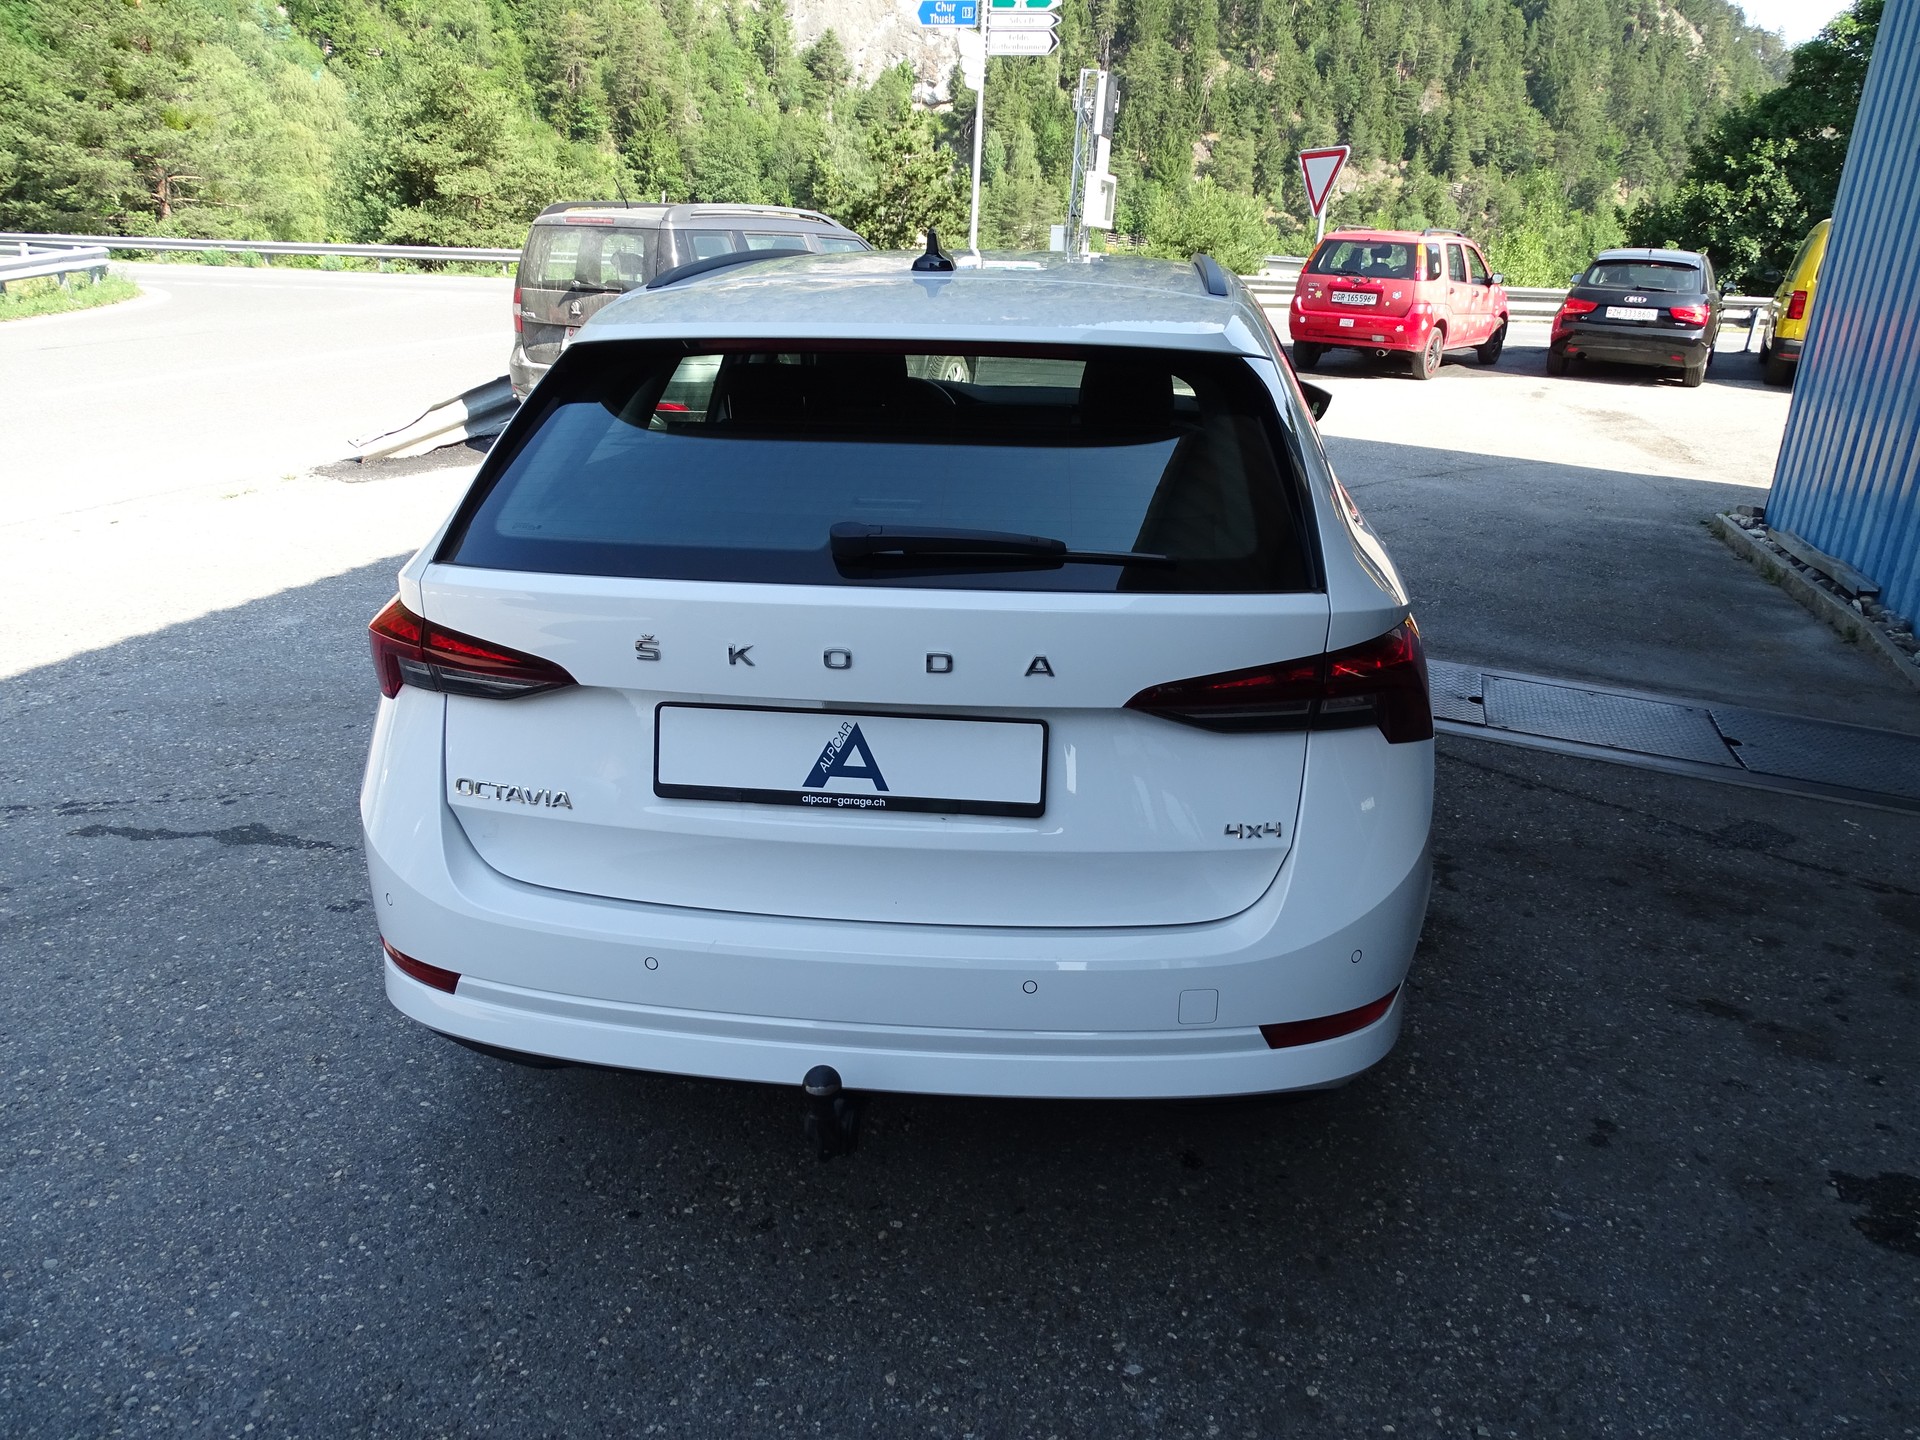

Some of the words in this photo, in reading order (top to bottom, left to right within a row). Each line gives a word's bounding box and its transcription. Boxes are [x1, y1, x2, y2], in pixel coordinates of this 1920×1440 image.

[935, 1, 956, 12] Chur
[930, 13, 956, 25] Thusis
[634, 633, 1056, 678] ŠKODA
[820, 721, 853, 774] ALPCAR
[455, 777, 573, 810] OCTAVIA
[802, 794, 886, 808] alpcar-garage.ch
[1224, 822, 1282, 840] 4x4
